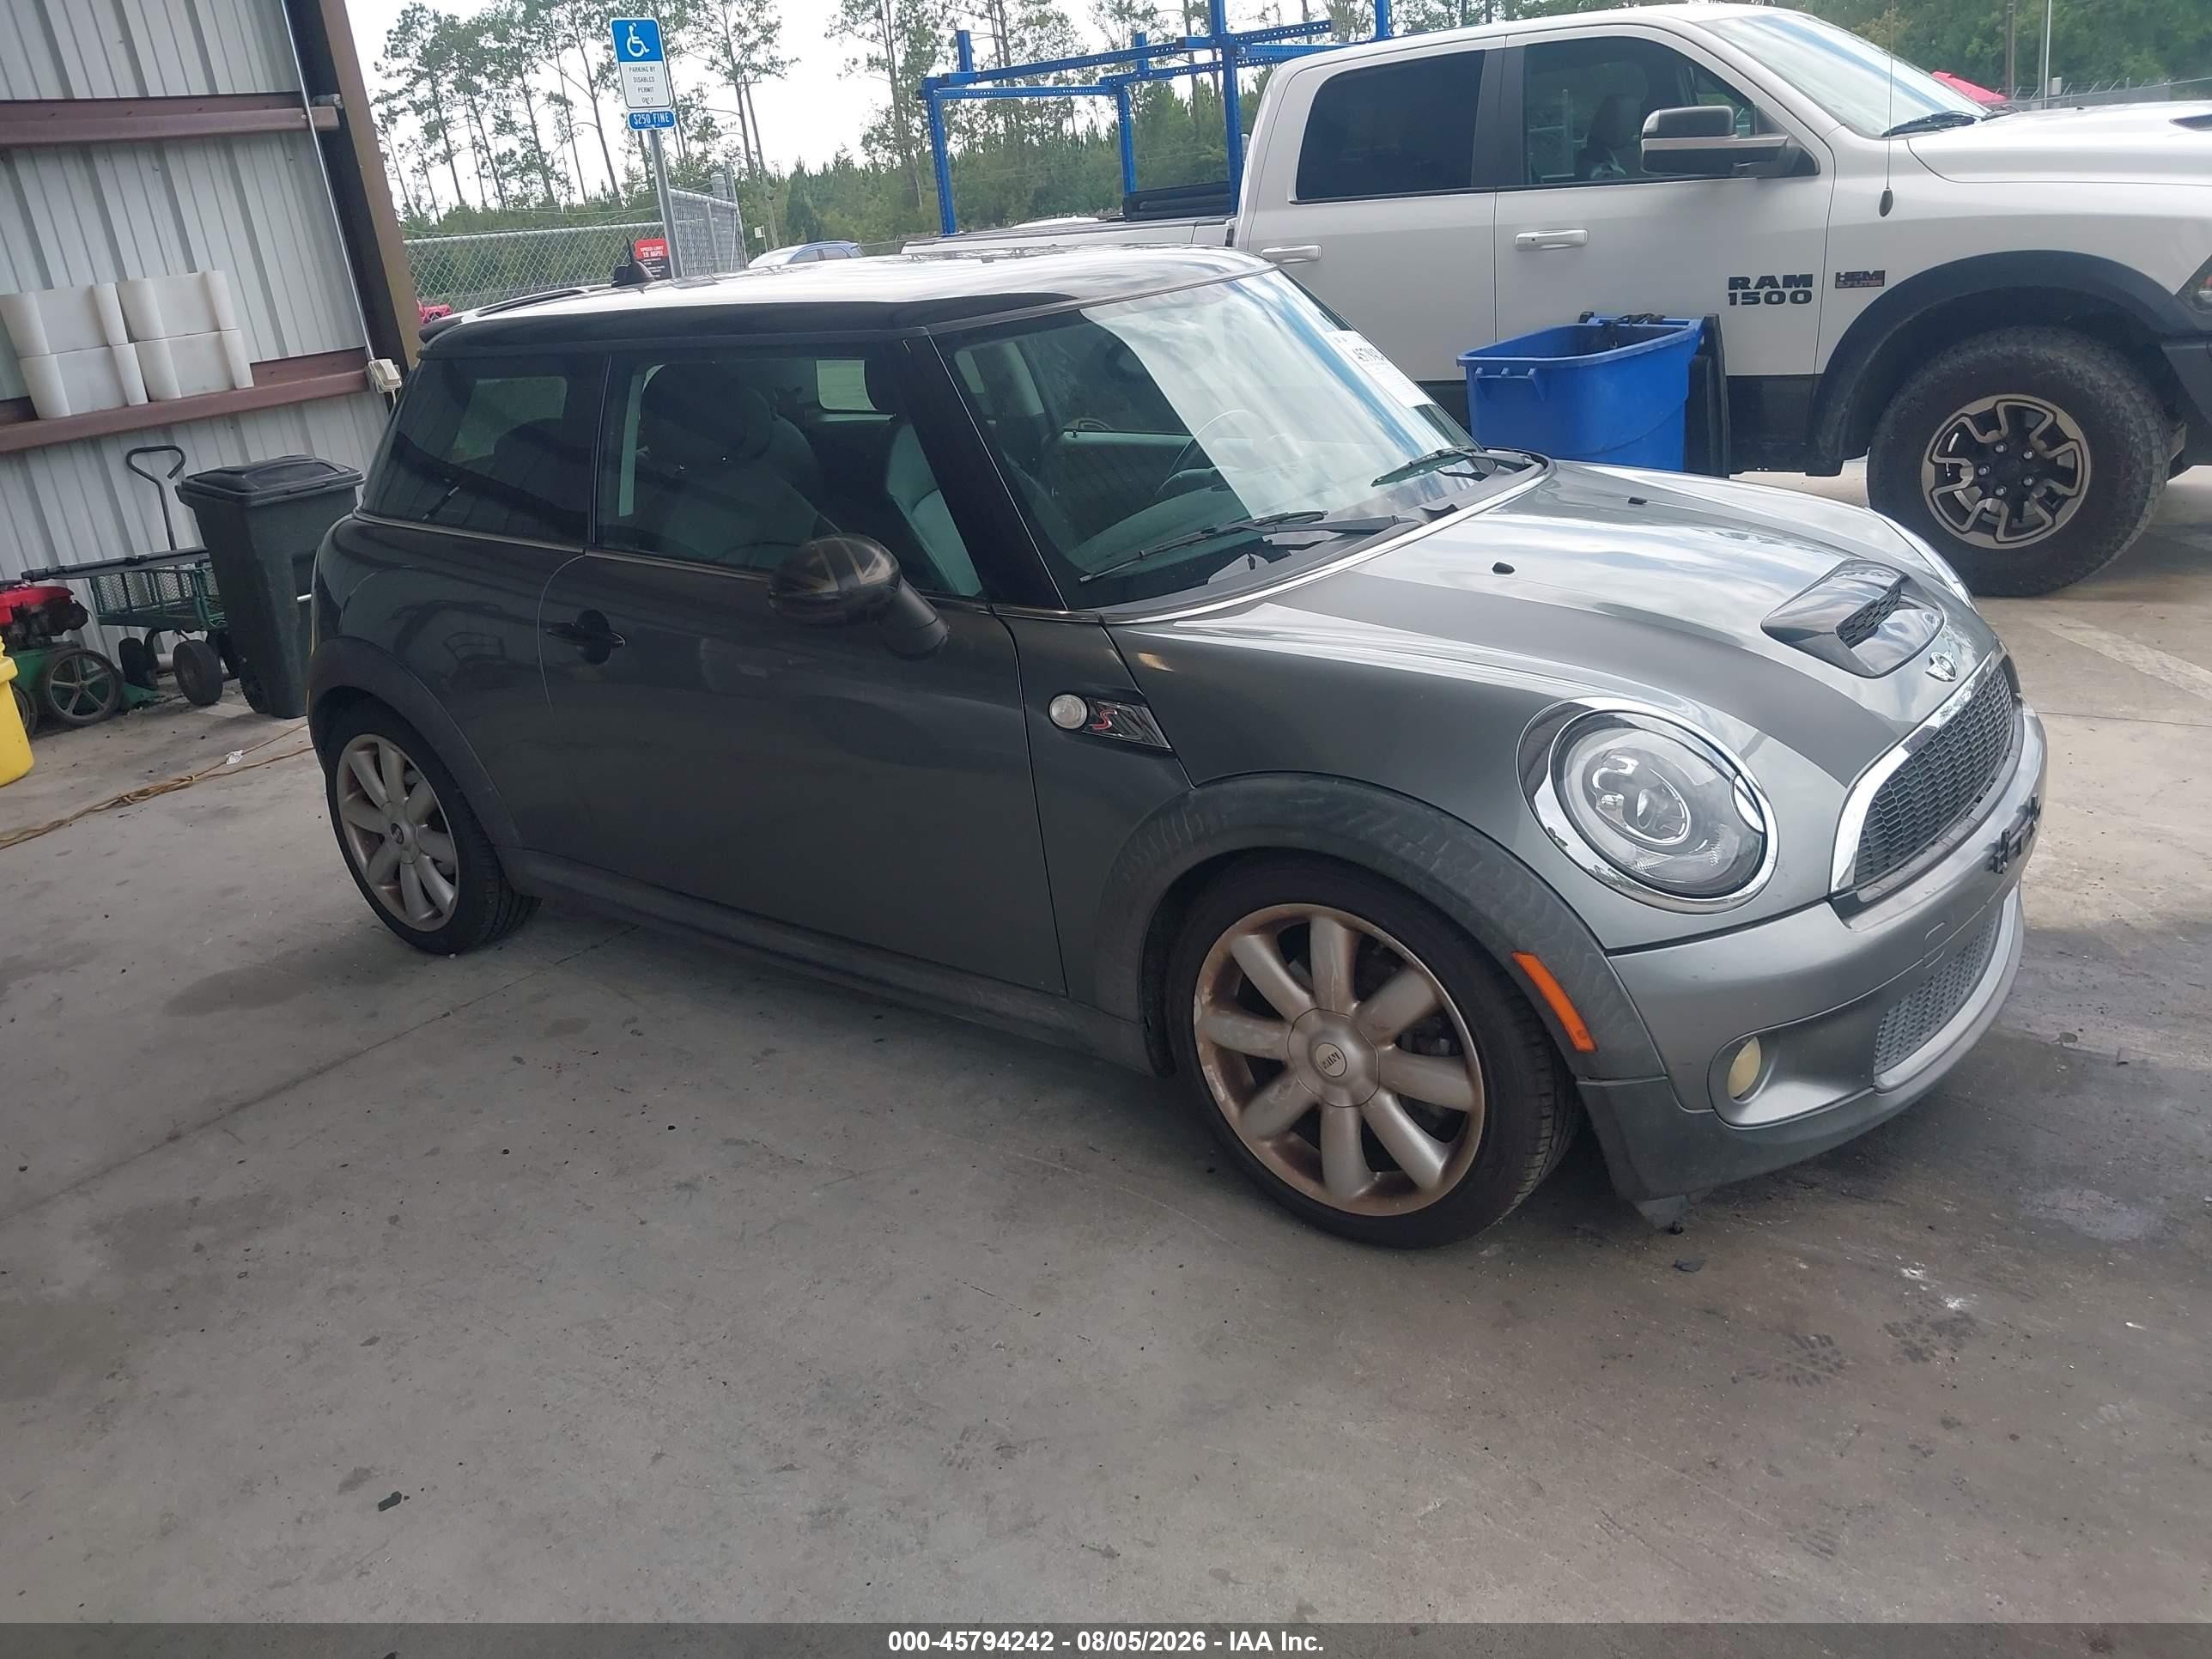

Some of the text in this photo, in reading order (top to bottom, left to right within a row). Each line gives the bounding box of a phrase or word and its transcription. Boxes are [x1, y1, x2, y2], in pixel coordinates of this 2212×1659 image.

[633, 113, 670, 125] $250 FINE
[1728, 274, 1814, 290] RAM
[1728, 289, 1813, 306] 1500
[1091, 708, 1118, 730] S
